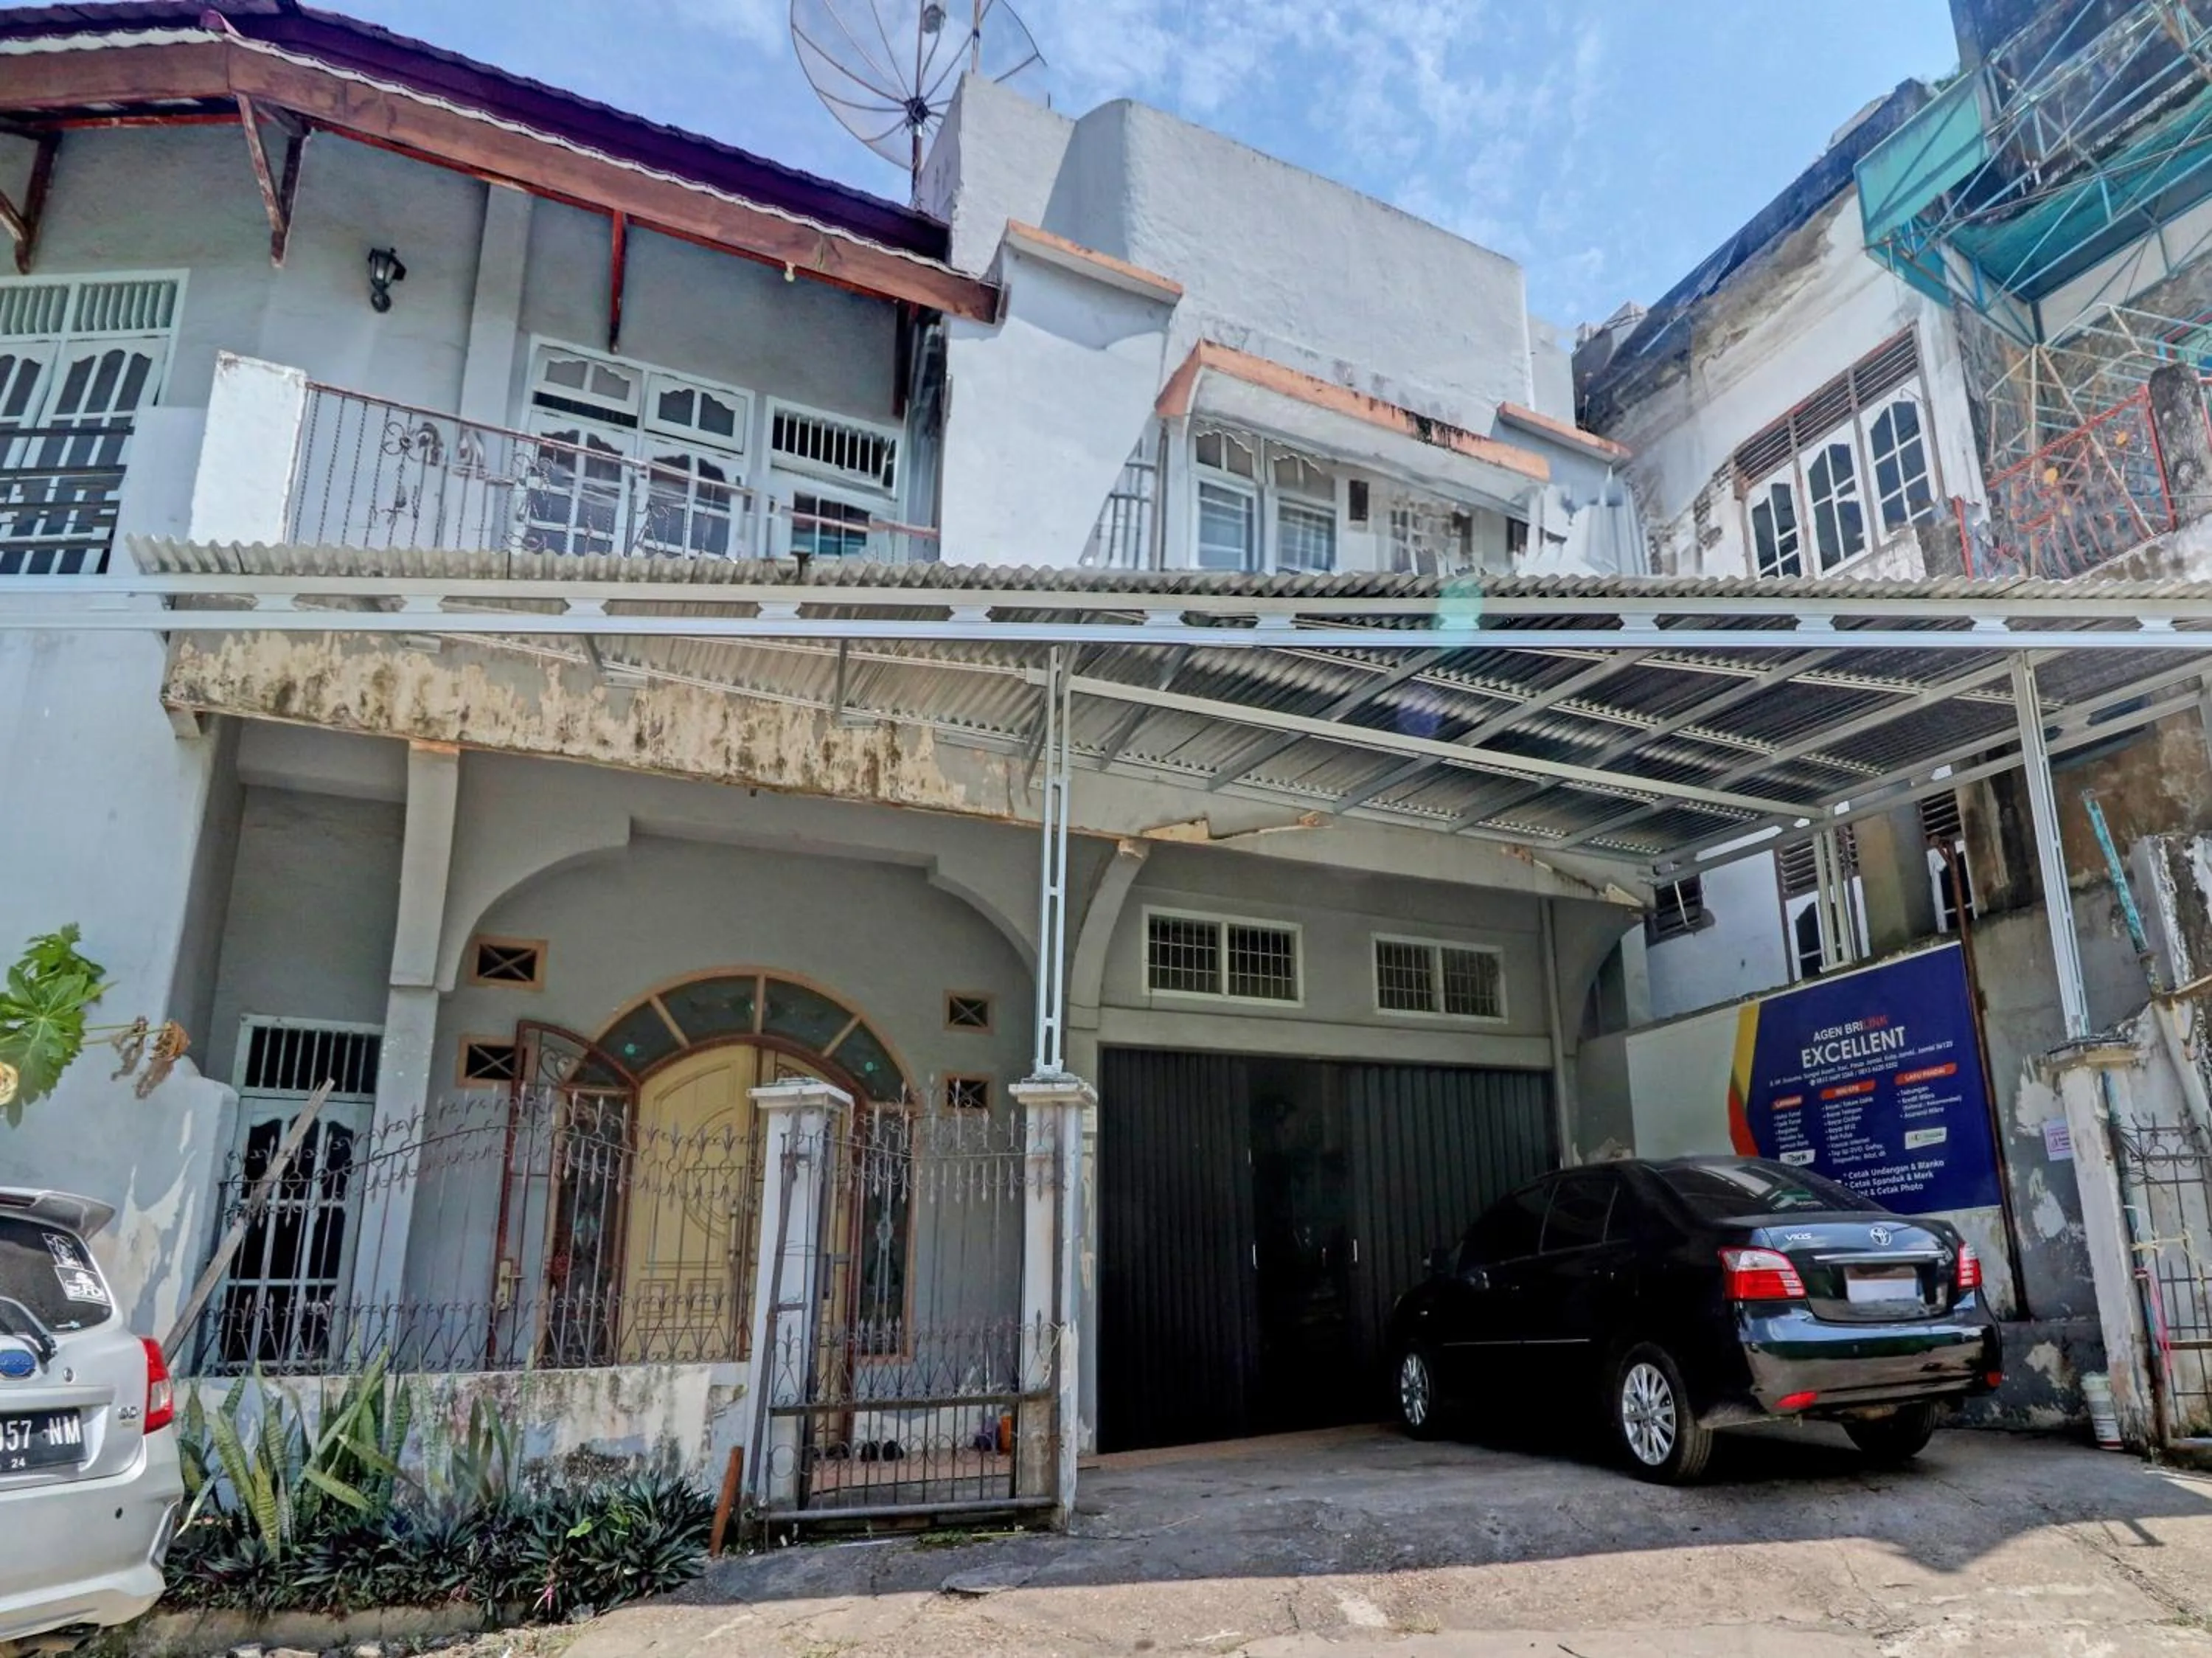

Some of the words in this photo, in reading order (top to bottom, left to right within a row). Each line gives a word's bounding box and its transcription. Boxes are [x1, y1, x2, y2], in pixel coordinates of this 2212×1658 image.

[1813, 1026, 1843, 1042] AGEN
[1801, 1026, 1905, 1069] EXCELLENT
[1848, 1169, 1869, 1179] Cetak
[1871, 1164, 1910, 1176] Undangan
[1849, 1179, 1871, 1189] Cetak
[1877, 1185, 1899, 1196] Cetak
[1900, 1182, 1924, 1193] Photo
[48, 1415, 81, 1446] NM
[11, 1457, 26, 1468] 24
